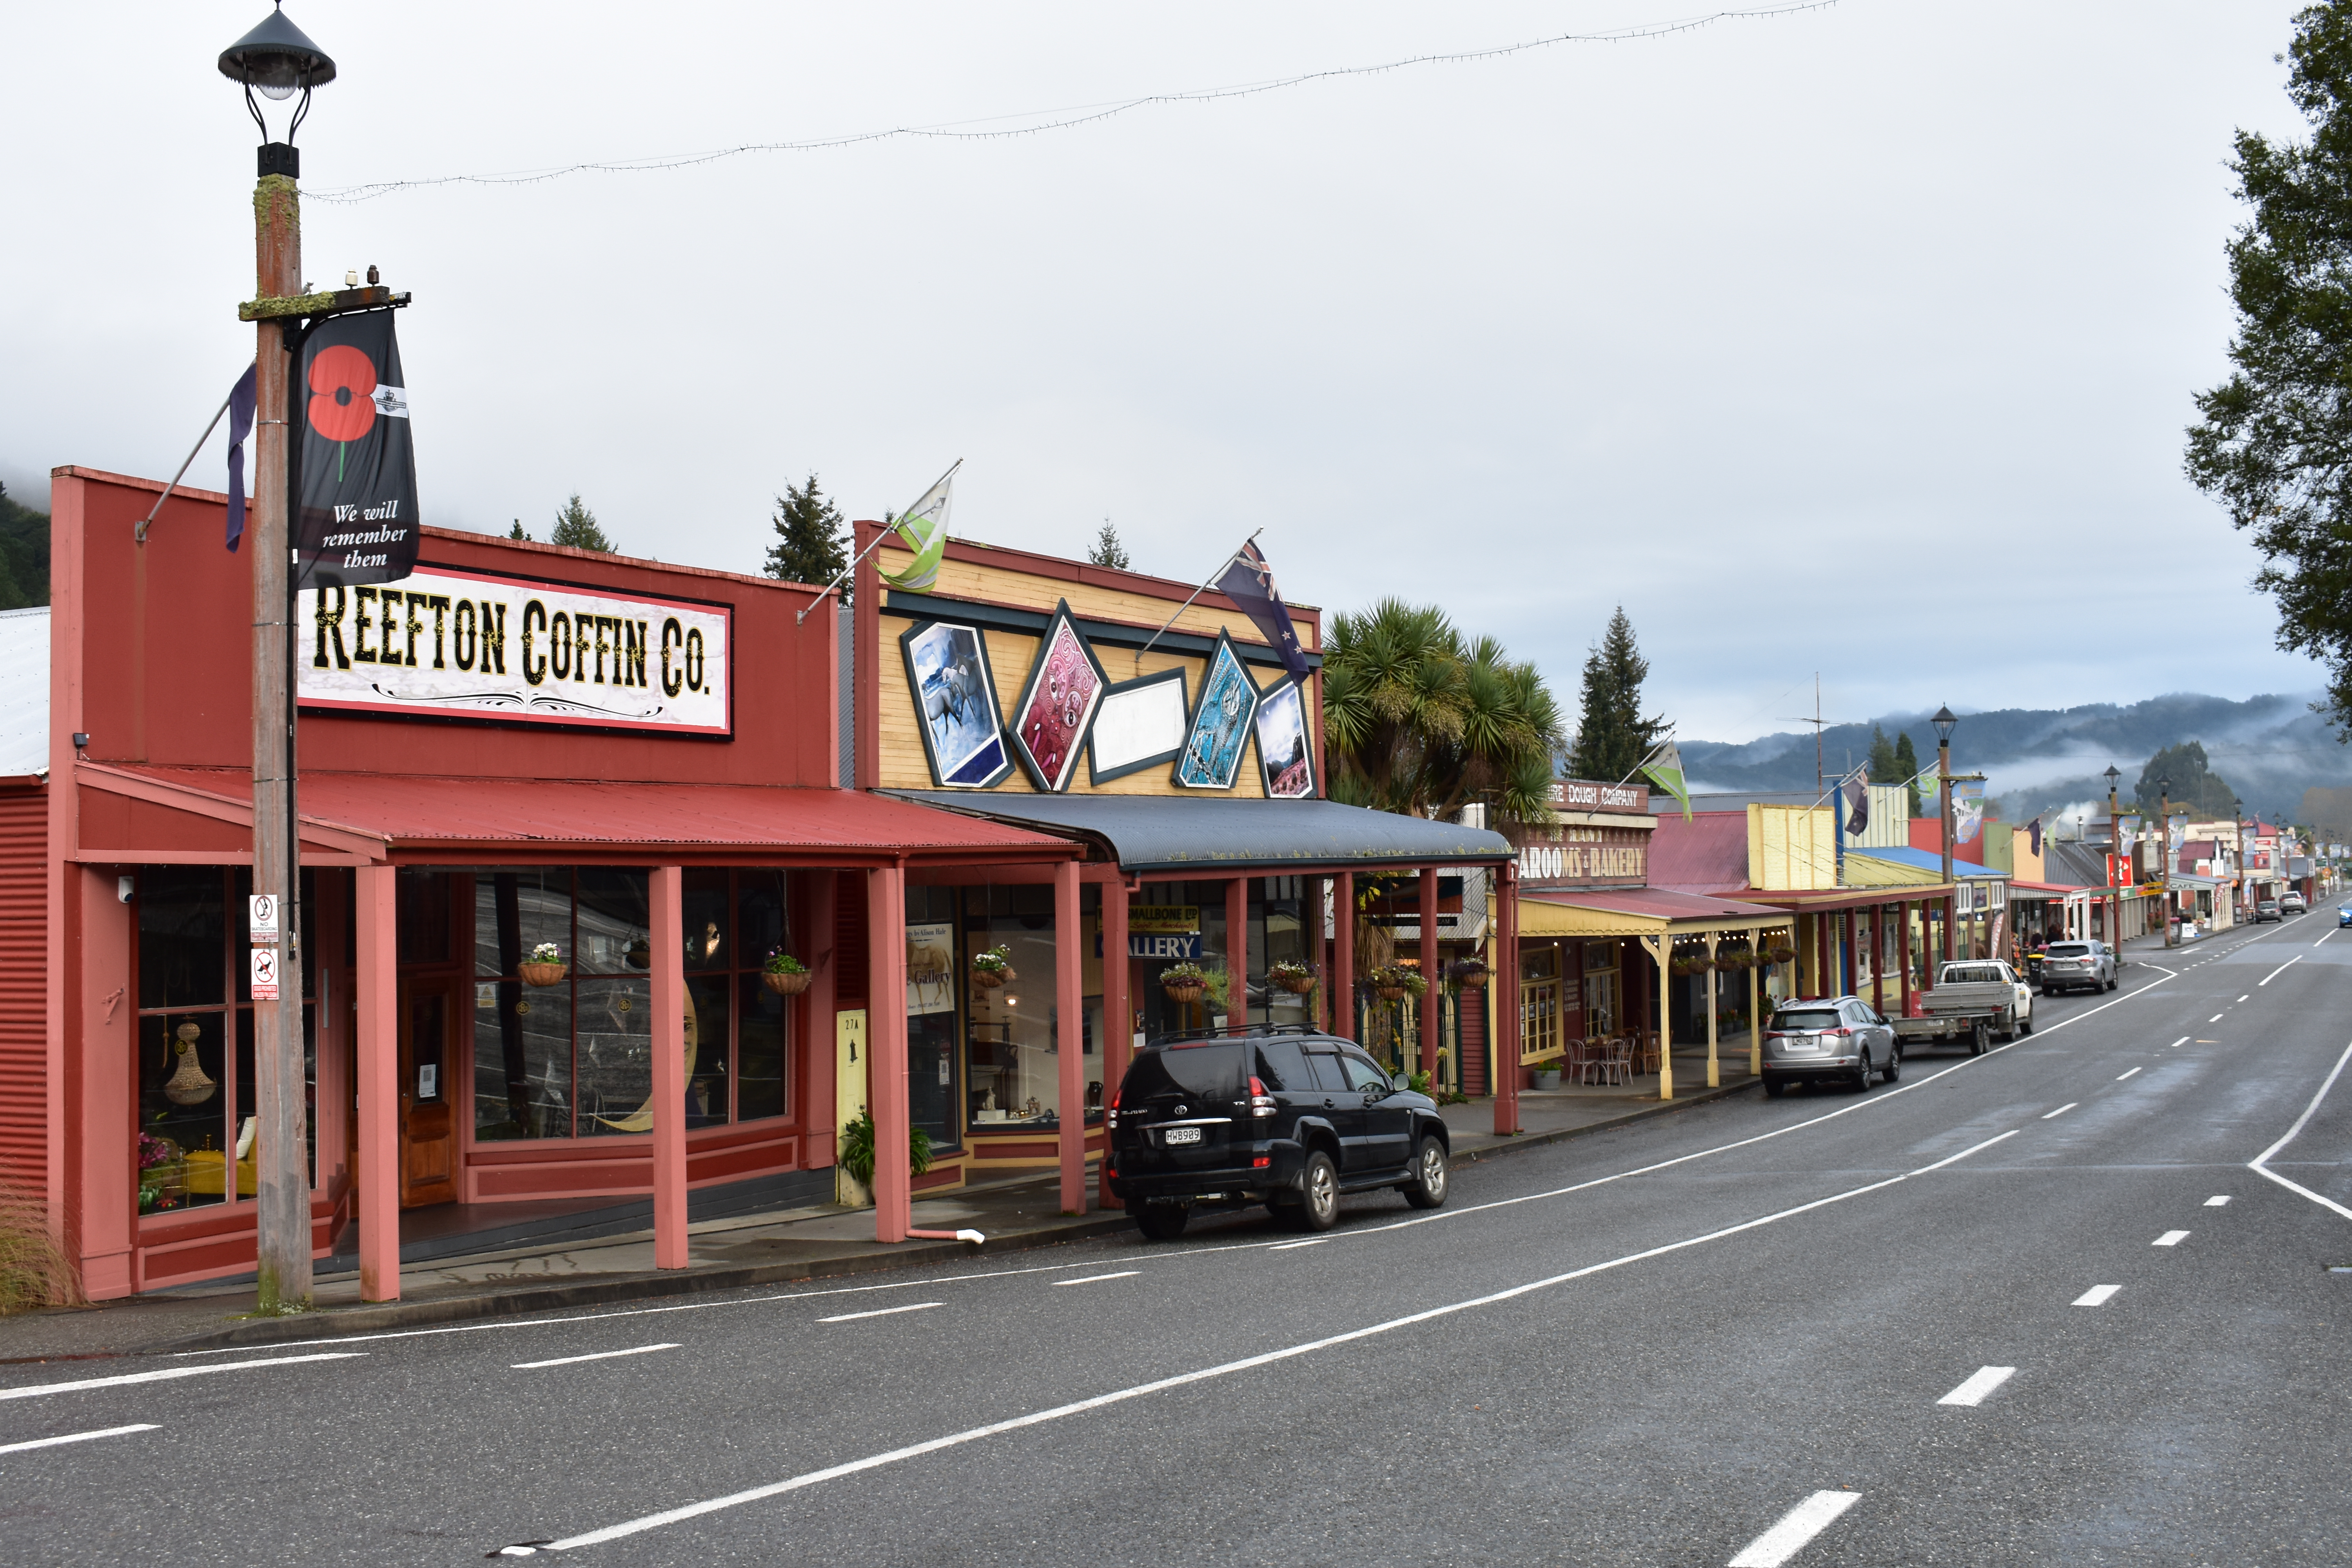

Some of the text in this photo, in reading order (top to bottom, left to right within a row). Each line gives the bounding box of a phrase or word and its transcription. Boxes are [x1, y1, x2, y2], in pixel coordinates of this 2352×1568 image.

[334, 500, 398, 523] We will
[322, 526, 408, 548] remember
[343, 552, 388, 568] them
[1568, 784, 1597, 804] DOUGH
[1602, 787, 1638, 806] COMPANY
[1583, 855, 1588, 868] &
[1590, 848, 1643, 877] BAKERY
[1101, 937, 1194, 957] ALLERY
[915, 969, 951, 985] Gallery
[846, 1019, 858, 1030] 27A
[1167, 1130, 1200, 1141] HWB909
